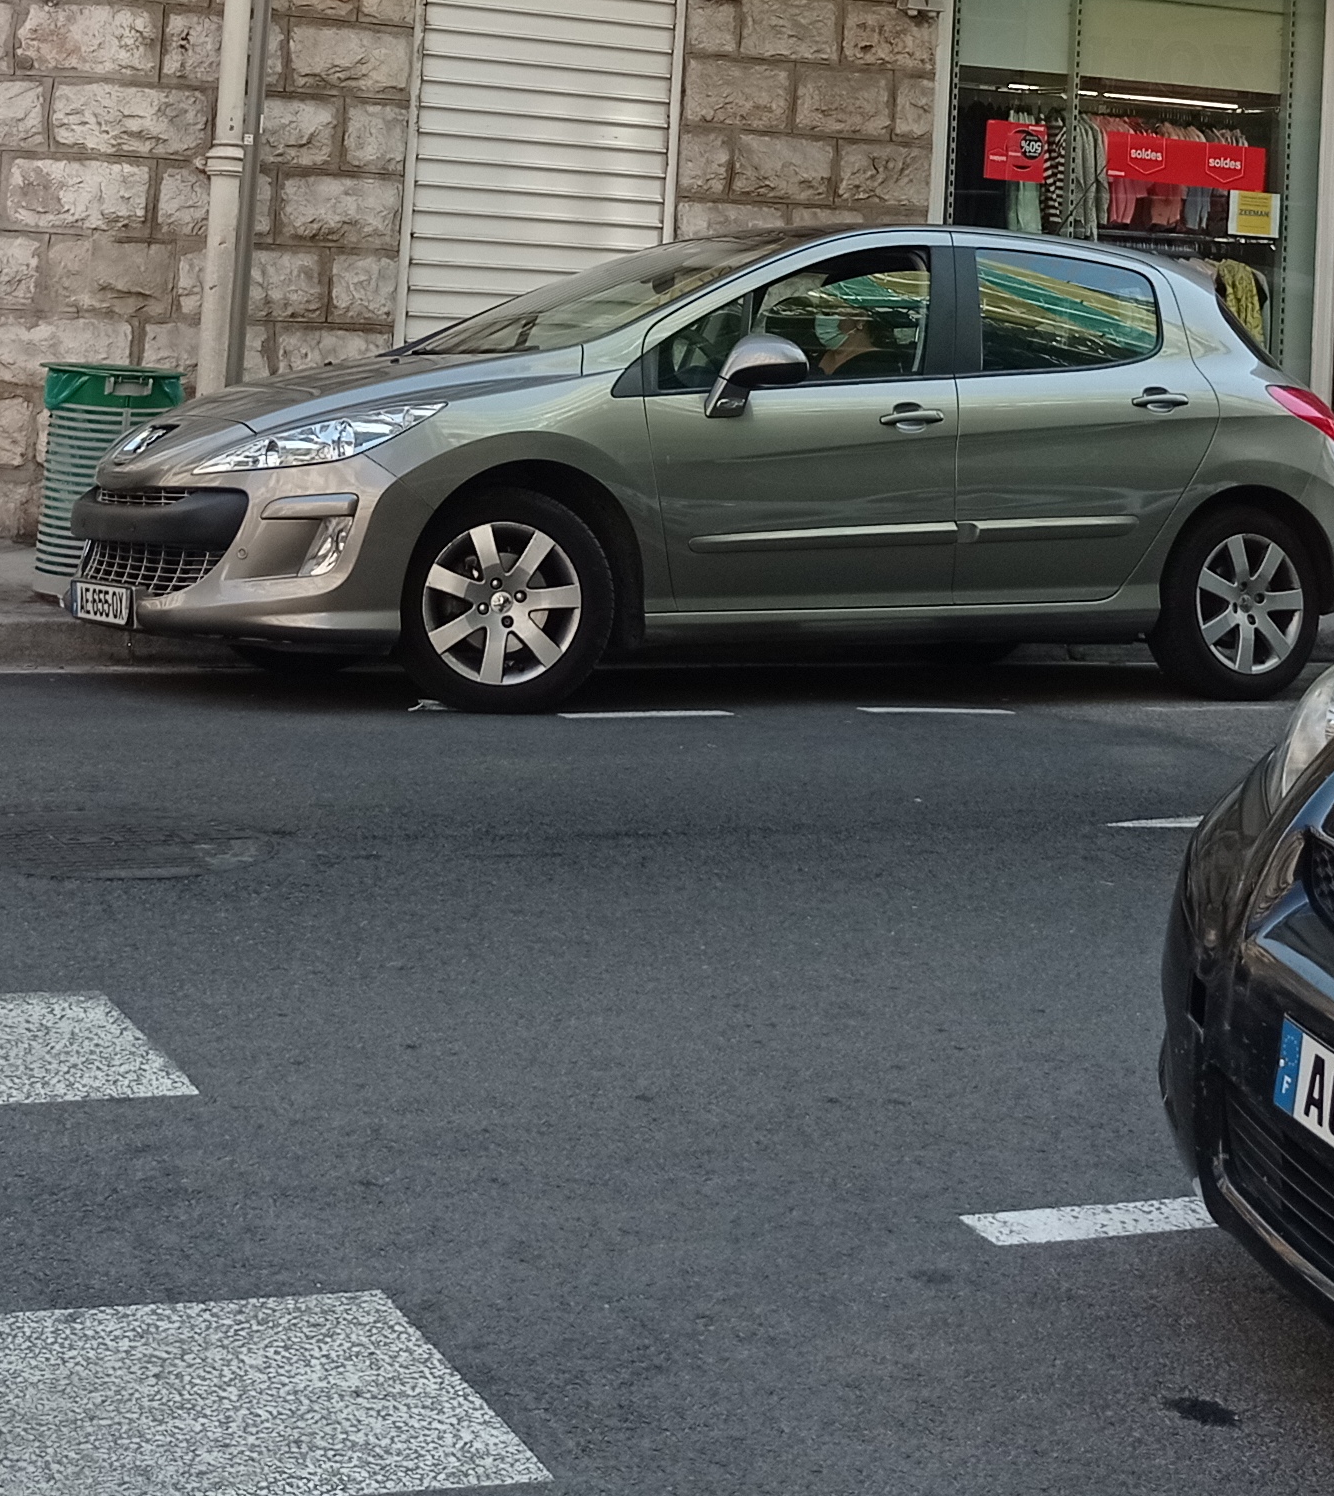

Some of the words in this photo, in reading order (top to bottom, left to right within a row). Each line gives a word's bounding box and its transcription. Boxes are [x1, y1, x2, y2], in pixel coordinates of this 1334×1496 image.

[1130, 147, 1163, 162] soldes
[1208, 156, 1242, 170] soldes
[1238, 208, 1270, 218] ZEEMAN
[1280, 1074, 1292, 1095] F
